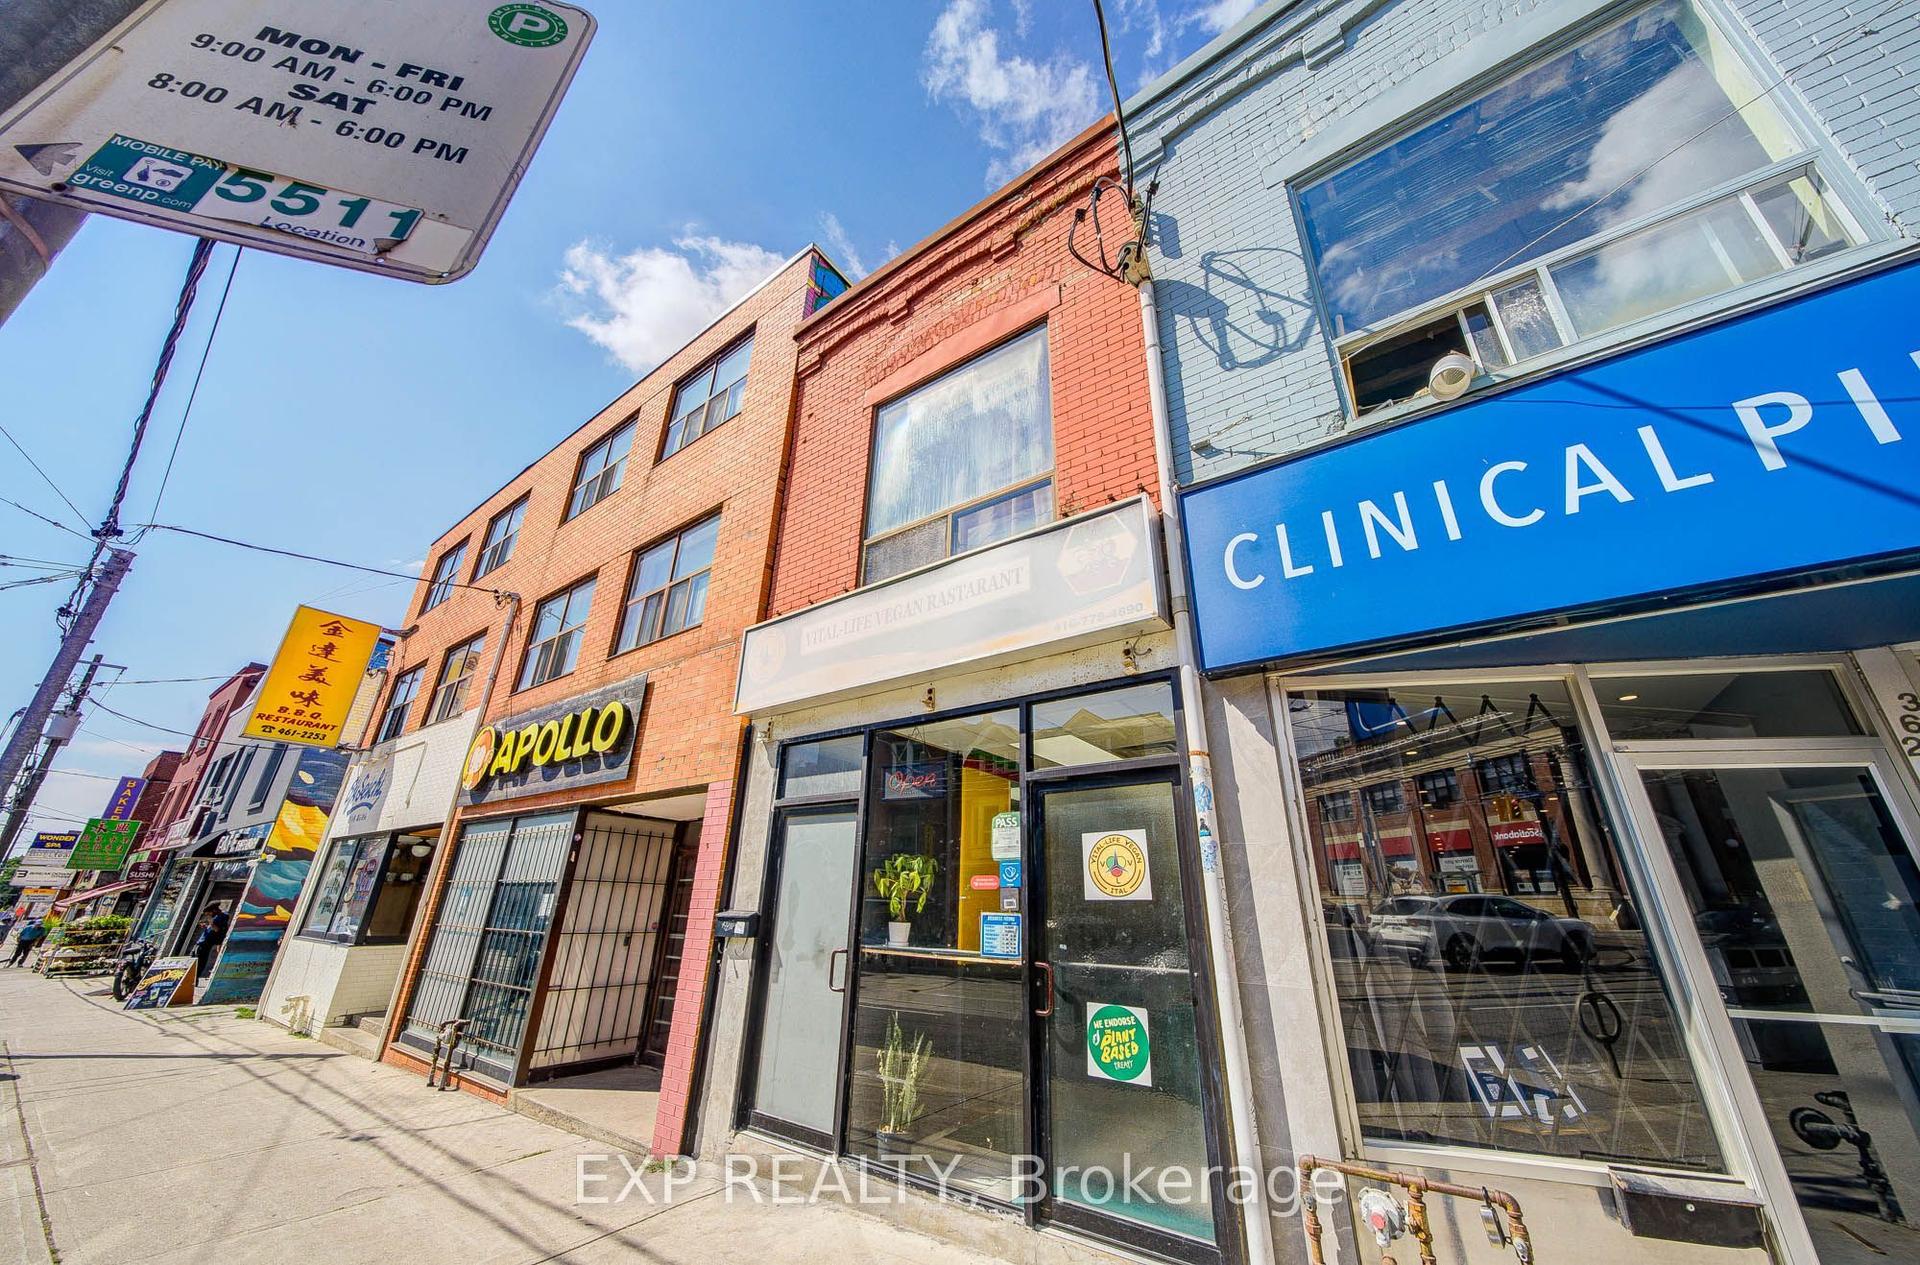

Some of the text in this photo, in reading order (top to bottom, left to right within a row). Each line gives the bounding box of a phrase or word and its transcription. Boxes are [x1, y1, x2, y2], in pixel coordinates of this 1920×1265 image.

[255, 26, 365, 64] MON
[395, 63, 465, 92] FRI
[190, 33, 266, 63] 9:00
[272, 56, 337, 83] AM
[366, 79, 433, 106] 6:00
[439, 98, 493, 122] PM
[288, 83, 377, 116] SAT
[147, 72, 229, 105] 8:00
[234, 96, 304, 124] AM
[335, 120, 406, 149] 6:00
[413, 137, 470, 165] PM
[111, 136, 225, 173] MOBILE PAY
[83, 163, 115, 178] Visit
[70, 172, 193, 211] greenp.com
[215, 168, 424, 240] 5511
[260, 215, 366, 249] Location
[1224, 425, 1715, 590] CLINICAL
[871, 597, 926, 628] VEGAN
[255, 713, 339, 732] RESTAURANT
[277, 706, 323, 720] B.B.Q.
[278, 727, 327, 741] 461-2253
[489, 700, 624, 777] APOLLO
[888, 770, 937, 797] Open
[995, 817, 1018, 828] PASS
[39, 834, 76, 842] WONDER
[1125, 840, 1142, 864] VEGAN
[128, 871, 156, 879] SUSHI
[1093, 1016, 1137, 1029] WE ENDORSE
[1100, 1028, 1136, 1051] PLANT
[1100, 1041, 1139, 1064] BASED
